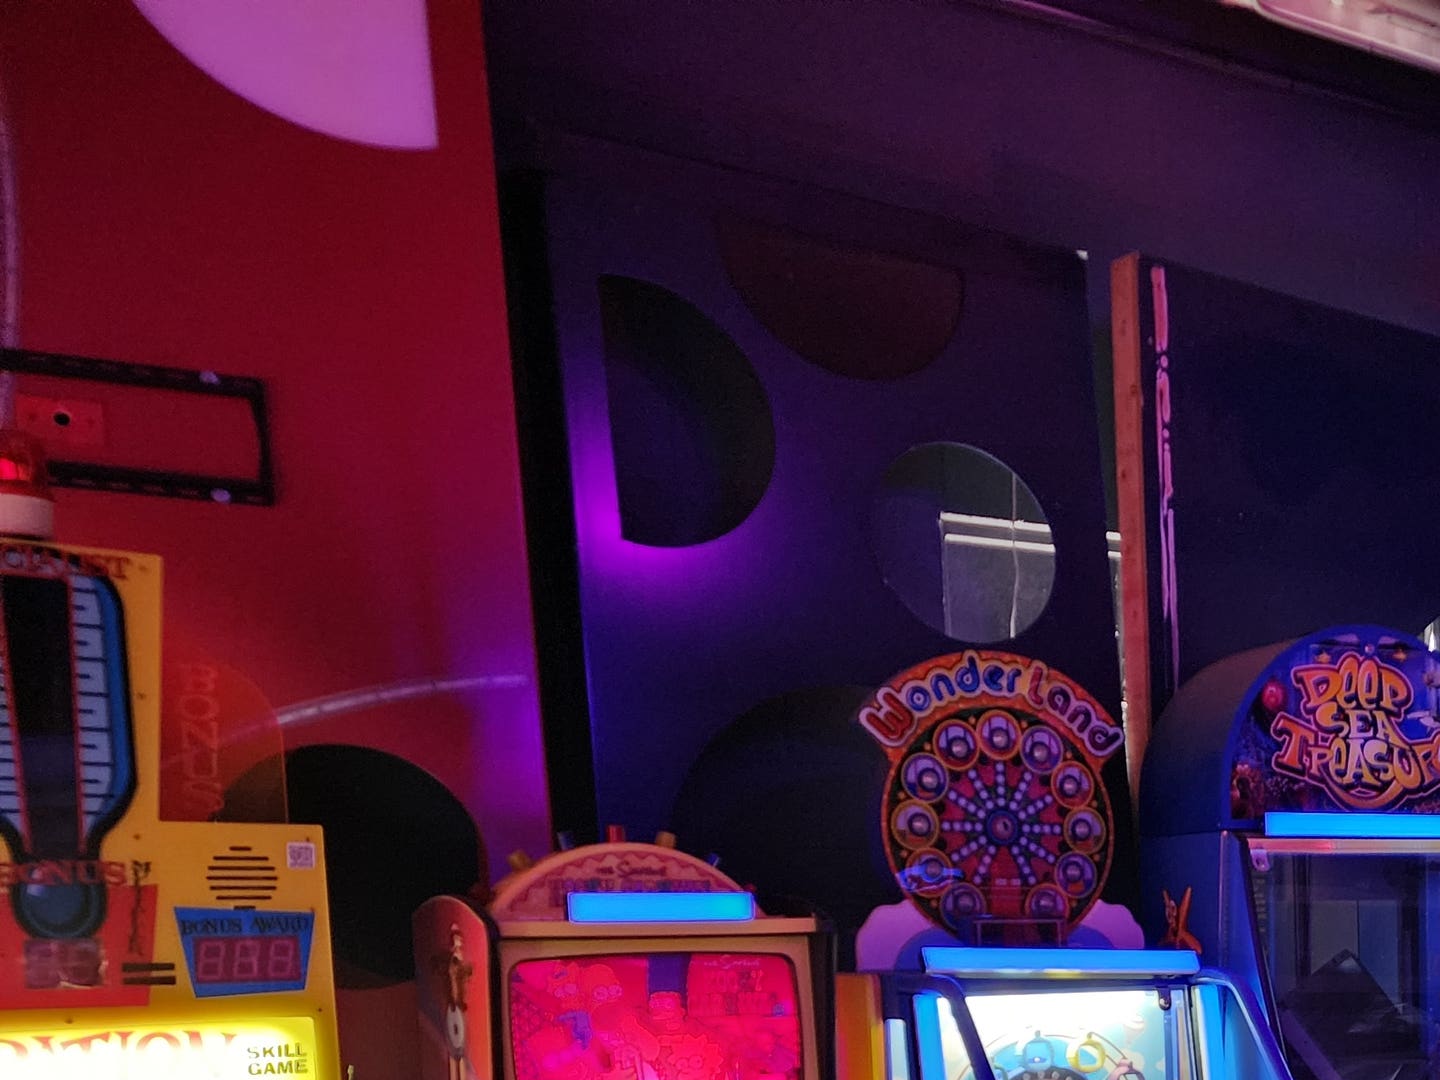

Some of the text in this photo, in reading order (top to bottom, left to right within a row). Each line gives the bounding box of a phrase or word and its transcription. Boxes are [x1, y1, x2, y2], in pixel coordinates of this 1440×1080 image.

[862, 654, 1124, 754] Wonder Land
[1314, 701, 1398, 745] SEA
[247, 1042, 308, 1059] SKILL
[248, 1058, 309, 1076] GAME
